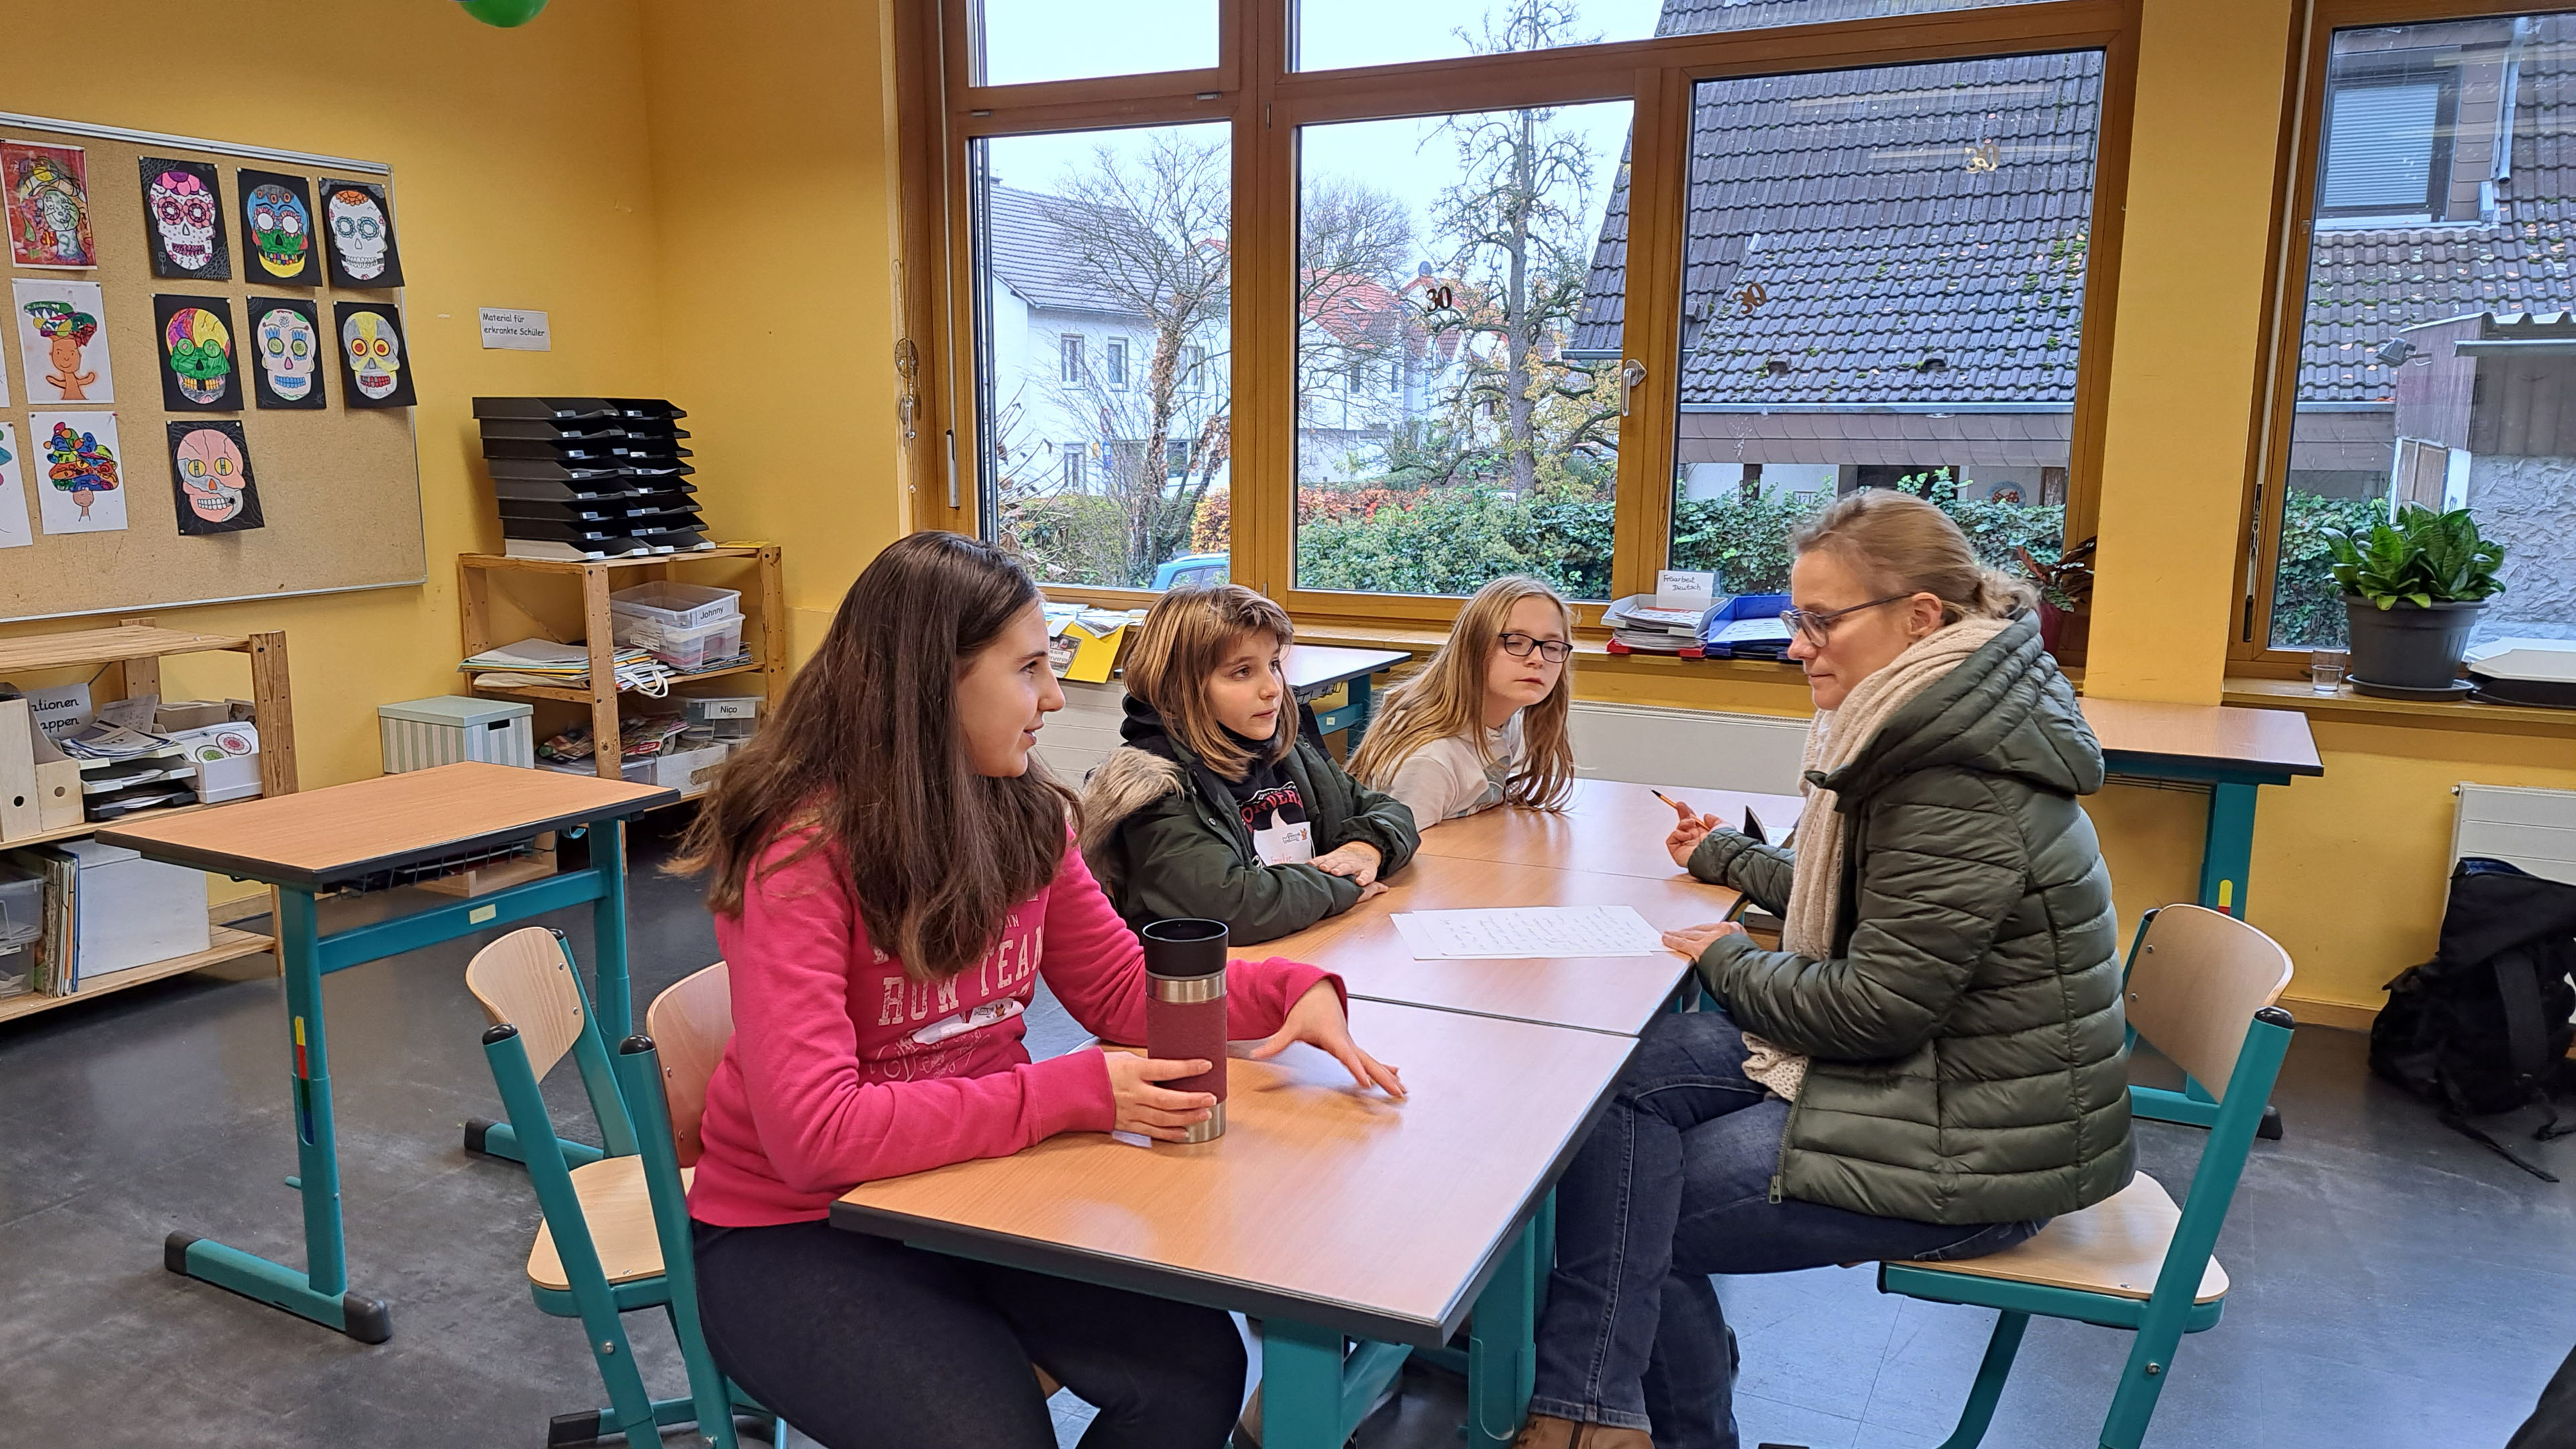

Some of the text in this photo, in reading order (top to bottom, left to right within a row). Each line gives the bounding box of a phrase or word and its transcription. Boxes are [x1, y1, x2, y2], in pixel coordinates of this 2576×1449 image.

[1964, 144, 2000, 174] 30
[1426, 286, 1452, 313] 30
[1732, 282, 1766, 315] 30
[482, 313, 525, 323] Material für
[484, 325, 545, 336] erkrankte Schüler
[700, 606, 724, 620] Johnny
[720, 705, 737, 714] Nico
